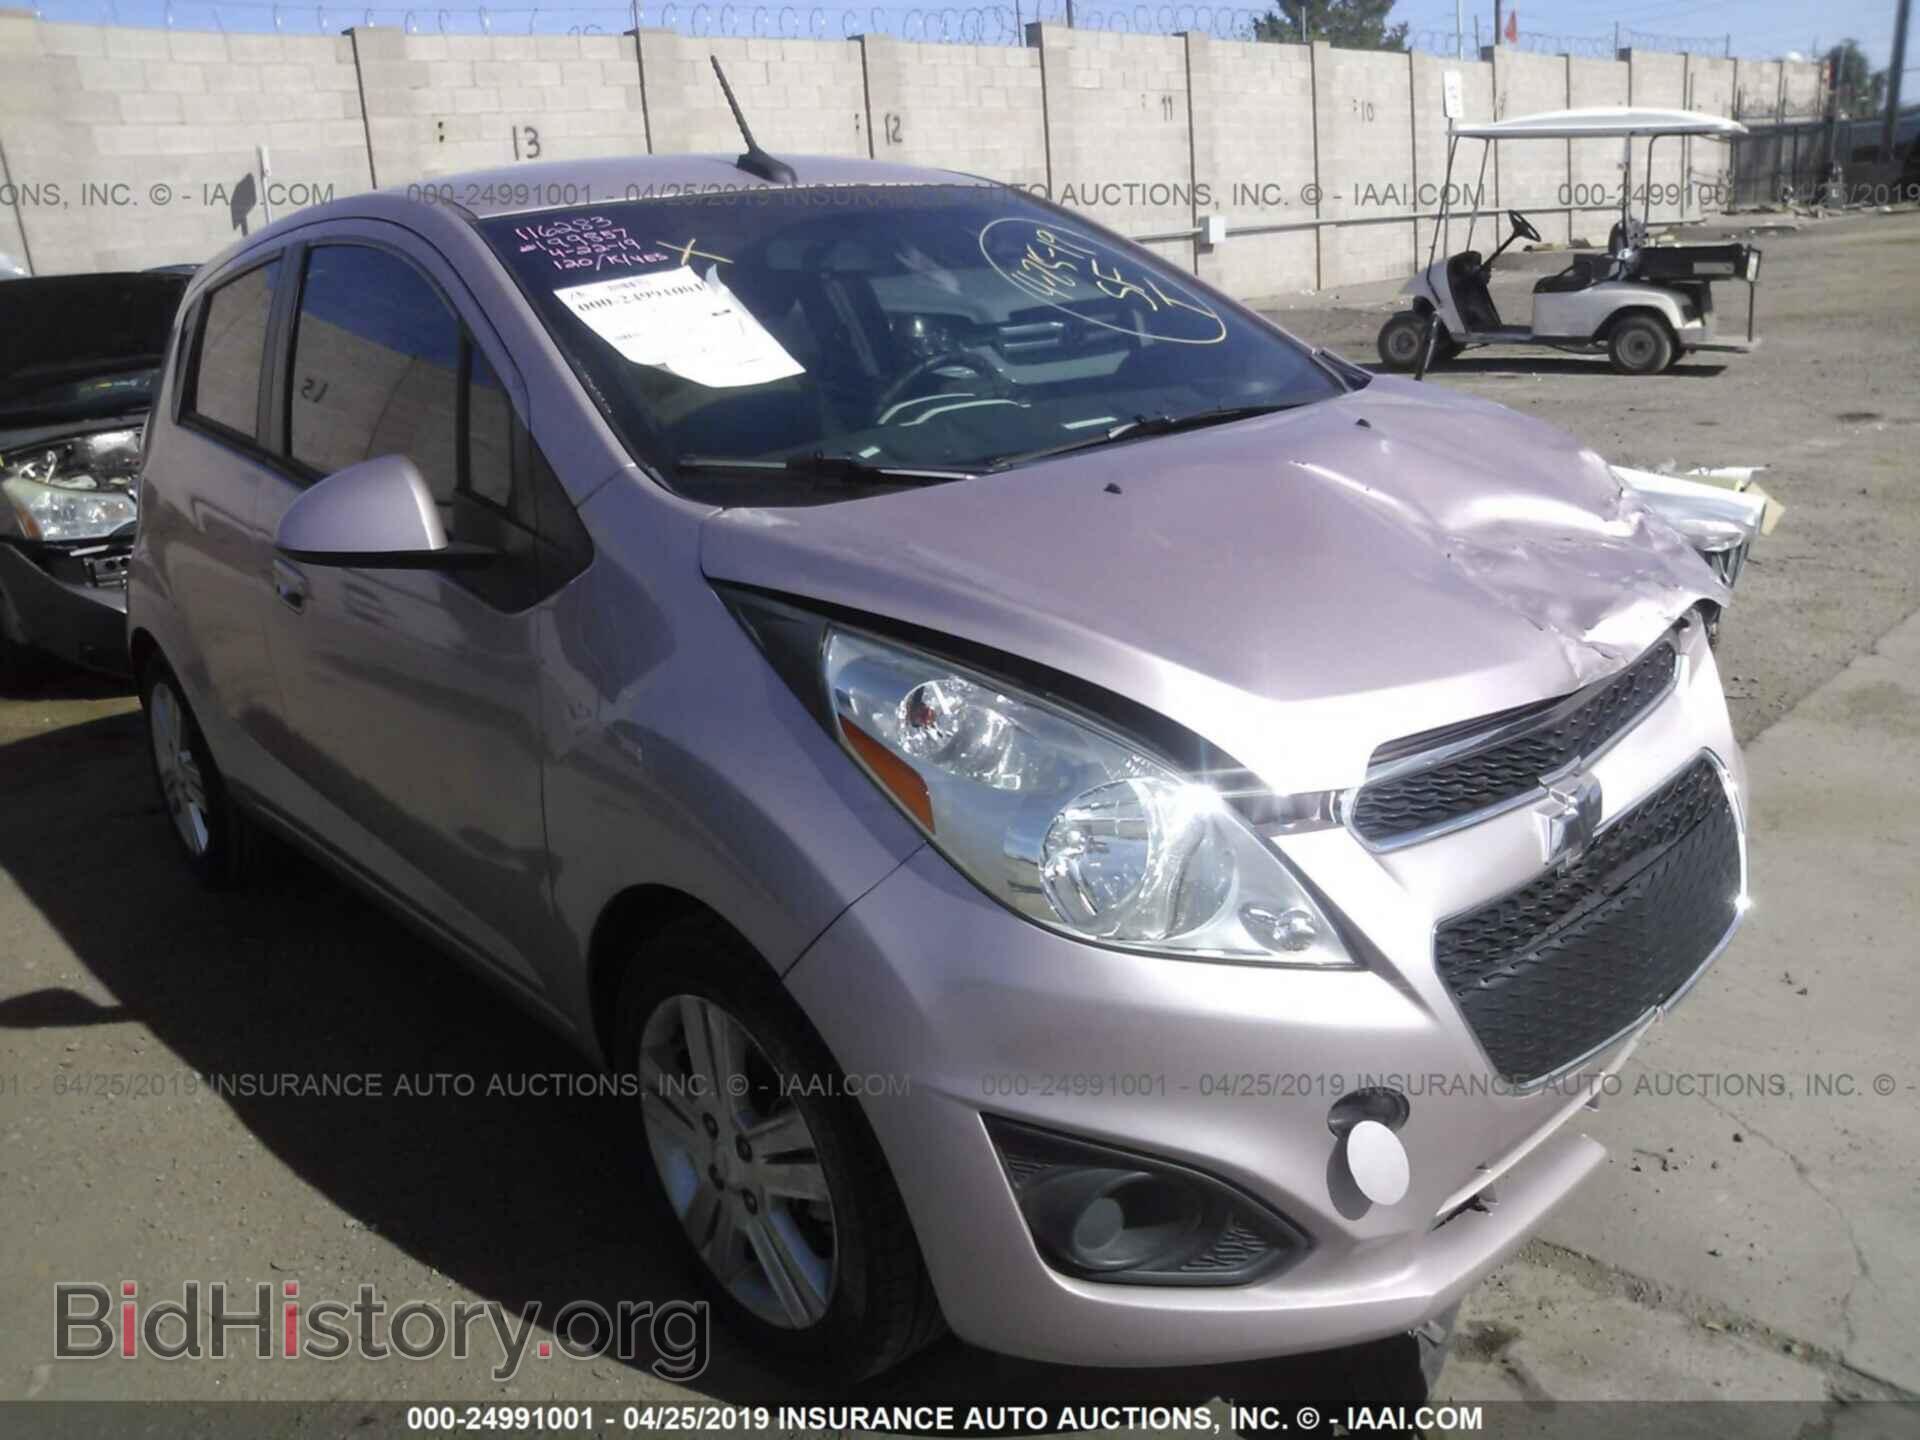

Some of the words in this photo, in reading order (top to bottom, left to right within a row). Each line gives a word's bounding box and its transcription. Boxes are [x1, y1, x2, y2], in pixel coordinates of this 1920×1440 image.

[512, 126, 541, 161] 13
[884, 113, 903, 146] 12
[515, 216, 612, 241] 116283
